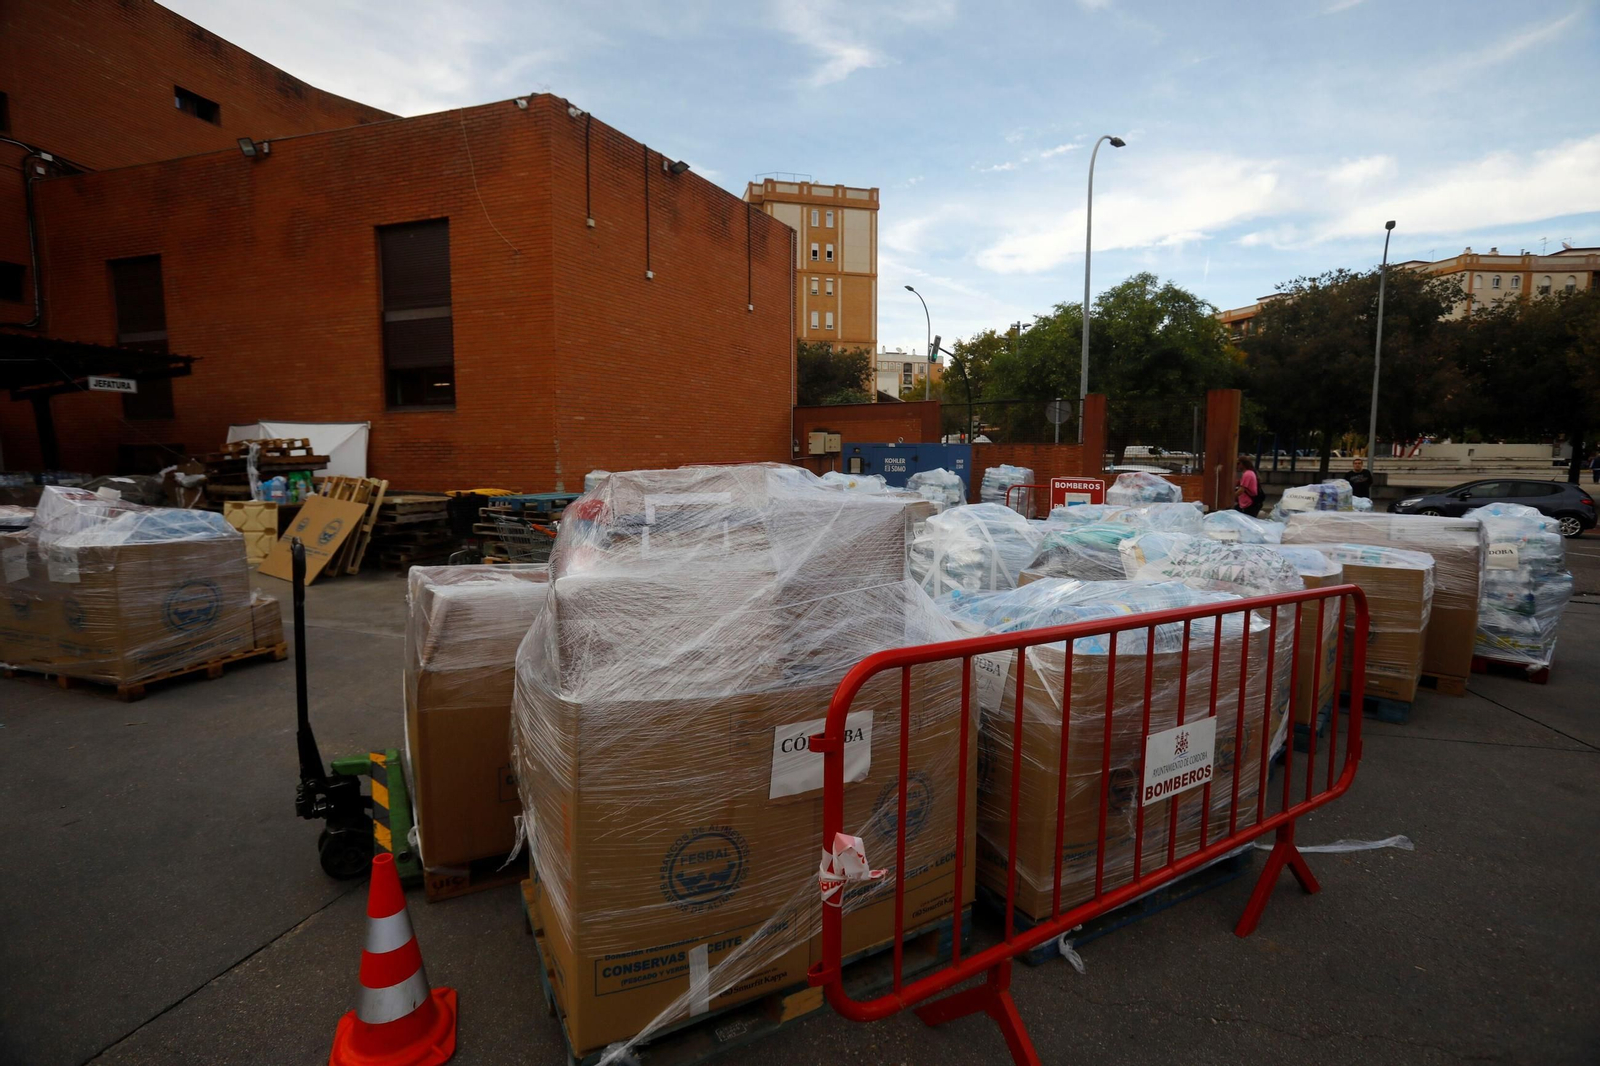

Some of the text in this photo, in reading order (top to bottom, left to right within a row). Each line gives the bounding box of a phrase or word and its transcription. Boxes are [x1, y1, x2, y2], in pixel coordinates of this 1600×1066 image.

[93, 380, 131, 389] JEFATURA
[1055, 482, 1101, 490] BOMBEROS
[782, 728, 864, 753] CÓBA
[1152, 759, 1184, 778] AYUNTAMIENTO
[1184, 757, 1190, 767] DE
[1145, 764, 1211, 800] BOMBEROS
[660, 833, 690, 872] BANCOS
[691, 827, 706, 836] DE
[681, 848, 731, 866] FESBAL
[935, 851, 957, 867] LECH
[602, 951, 687, 978] CONSERVAS
[707, 936, 743, 955] CEITE
[666, 964, 691, 977] VERDU
[764, 972, 788, 985] Kappa
